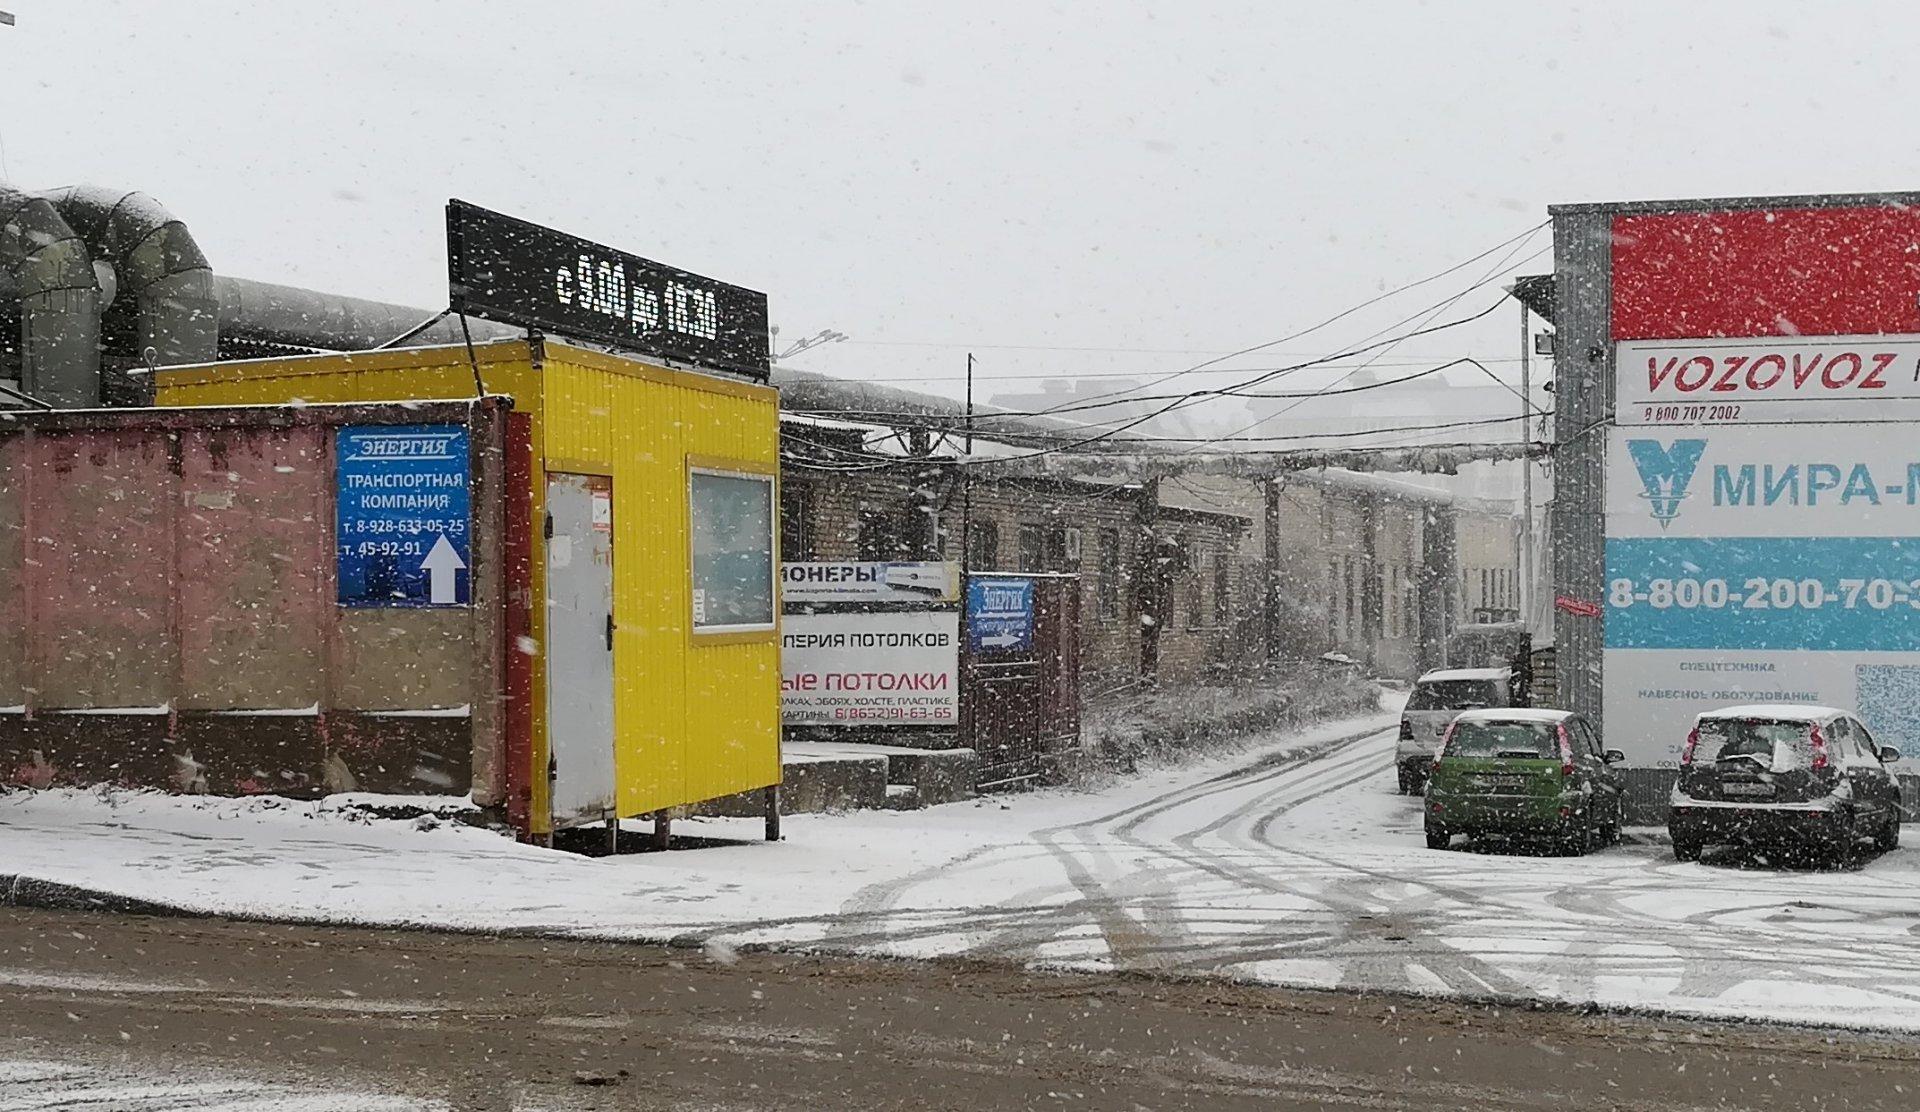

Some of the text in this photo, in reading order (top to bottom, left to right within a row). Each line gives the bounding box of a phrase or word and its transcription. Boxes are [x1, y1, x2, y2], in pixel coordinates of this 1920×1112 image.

[631, 285, 659, 335] до
[1647, 352, 1898, 393] VOZOVOZ
[1656, 406, 1679, 421] 800
[1683, 406, 1706, 420] 707
[1709, 405, 1741, 420] 2002
[360, 440, 449, 455] ЭНЕРГИЯ
[346, 473, 463, 488] ТРАНСПОРТНАЯ
[361, 494, 449, 509] КОМПАНИЯ
[357, 519, 464, 533] 8-928-633-05-25
[358, 541, 422, 556] 45-92-91
[983, 590, 1024, 610] ЭНЕРГИЯ
[783, 633, 949, 648] ПЕРИЯ ПОТОЛКОВ
[1679, 661, 1777, 674] СПЕЦТЕХНИКА
[1638, 689, 1819, 702] НАВЕСНОЕ ОБОРУДОВАНИЕ
